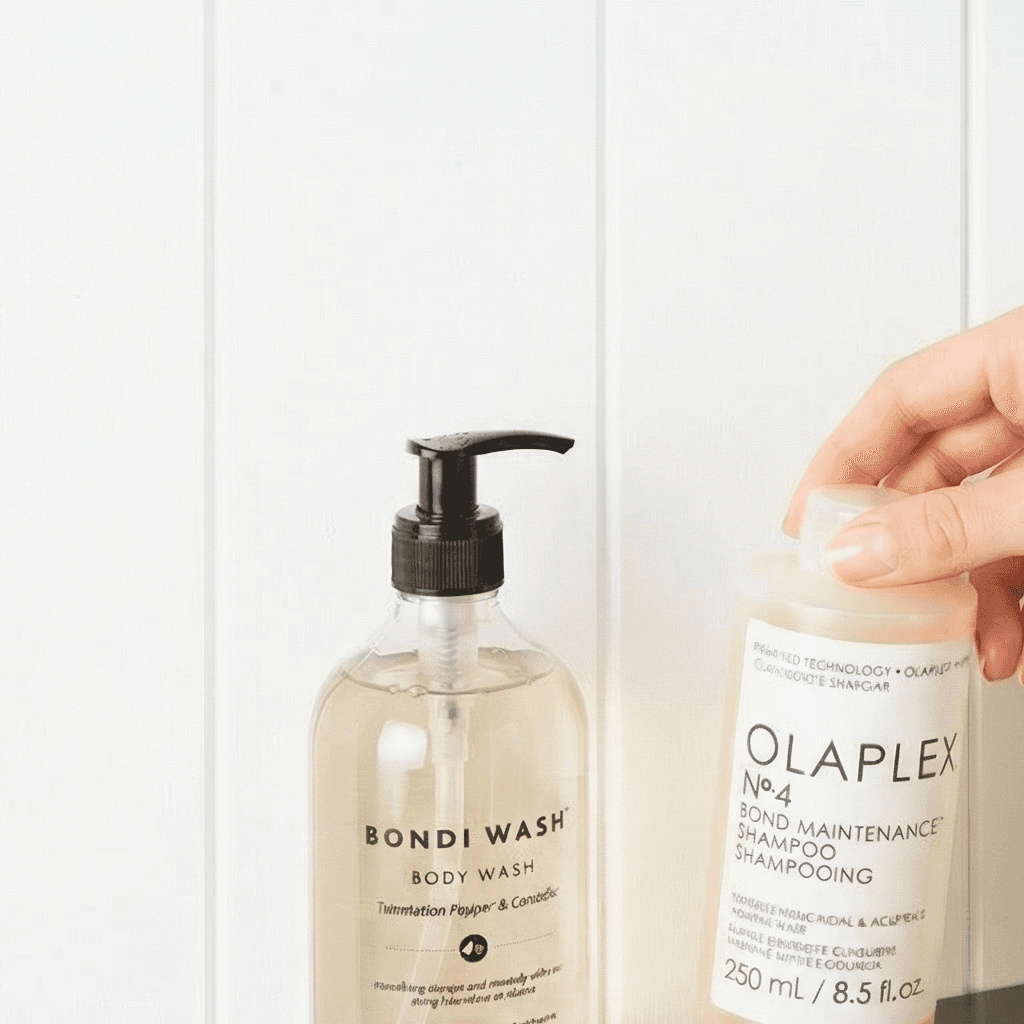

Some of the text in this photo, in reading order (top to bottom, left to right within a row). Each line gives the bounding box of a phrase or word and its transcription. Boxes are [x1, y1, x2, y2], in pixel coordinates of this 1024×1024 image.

[804, 657, 892, 678] TECHNOLOGY
[747, 723, 958, 783] OLAPLEX
[740, 802, 790, 830] BOND
[365, 824, 470, 849] BONDI
[737, 822, 836, 861] SHAMPOO
[411, 859, 534, 885] BODY WASH
[735, 843, 873, 885] SHAMPOOING
[725, 958, 762, 991] 250
[769, 976, 805, 1001] mL
[812, 979, 826, 1005] /
[832, 981, 873, 1005] 8.5
